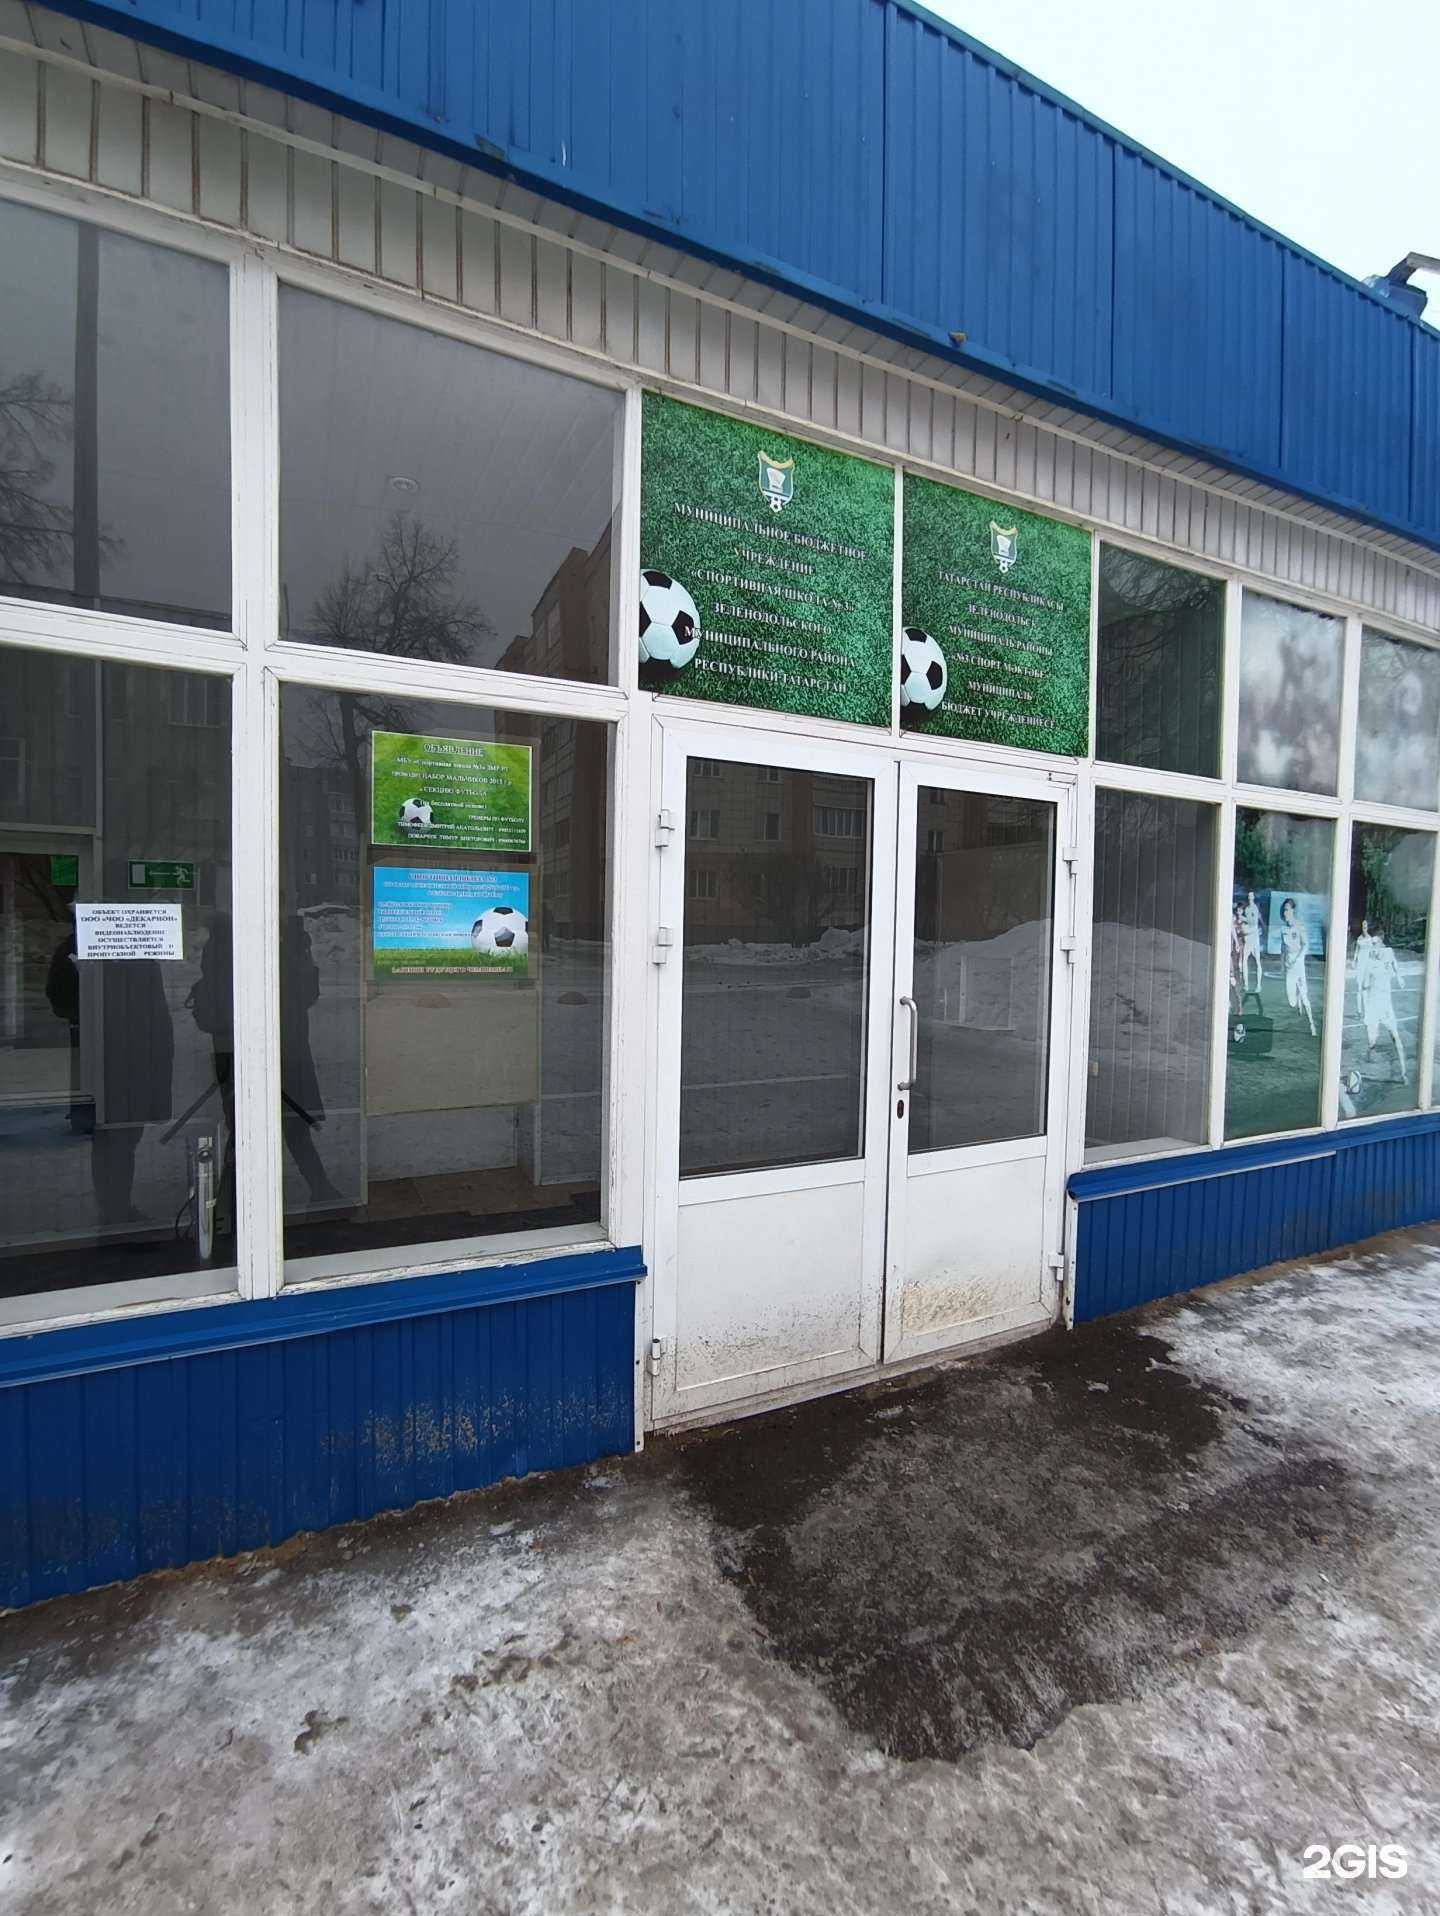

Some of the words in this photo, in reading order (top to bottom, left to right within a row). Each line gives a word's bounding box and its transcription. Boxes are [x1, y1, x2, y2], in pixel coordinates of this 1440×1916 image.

[674, 502, 792, 541] МУНИЦИПАЛЬНОЕ
[793, 533, 870, 561] БЮДЖЕТНОЕ
[734, 547, 816, 576] УЧРЕЖДЕНИЕ
[691, 568, 781, 596] «СПОРТИВНАЯ
[784, 587, 828, 607] ШКОЛА
[938, 570, 991, 593] ТАТАРСТАН
[993, 584, 1064, 612] РЕСПУБЛИКАСЫ
[713, 602, 832, 635] ЗЕЛЕНОДОЛЬСКОГО
[968, 603, 1036, 627] ЗЕЛЕНОДОЛЬСК
[684, 625, 808, 660] МУНИЦИПАЛЬНОГО
[810, 651, 855, 668] РАЙОНА
[949, 625, 1014, 648] МУНИЦИПАЛЬ
[1016, 641, 1053, 657] РАЙОНЫ
[694, 658, 779, 683] РЕСПУБЛИКИ
[782, 673, 848, 694] ТАТАРСТАН
[971, 655, 1001, 670] СПОРТ
[968, 680, 1033, 701] МУНИЦИПАЛЬ
[941, 701, 982, 717] БЮДЖЕТ
[984, 709, 1056, 729] УЧРЕЖДЕНИЕСЕ
[424, 743, 484, 757] ОБЪЯВЛЕНИЕ
